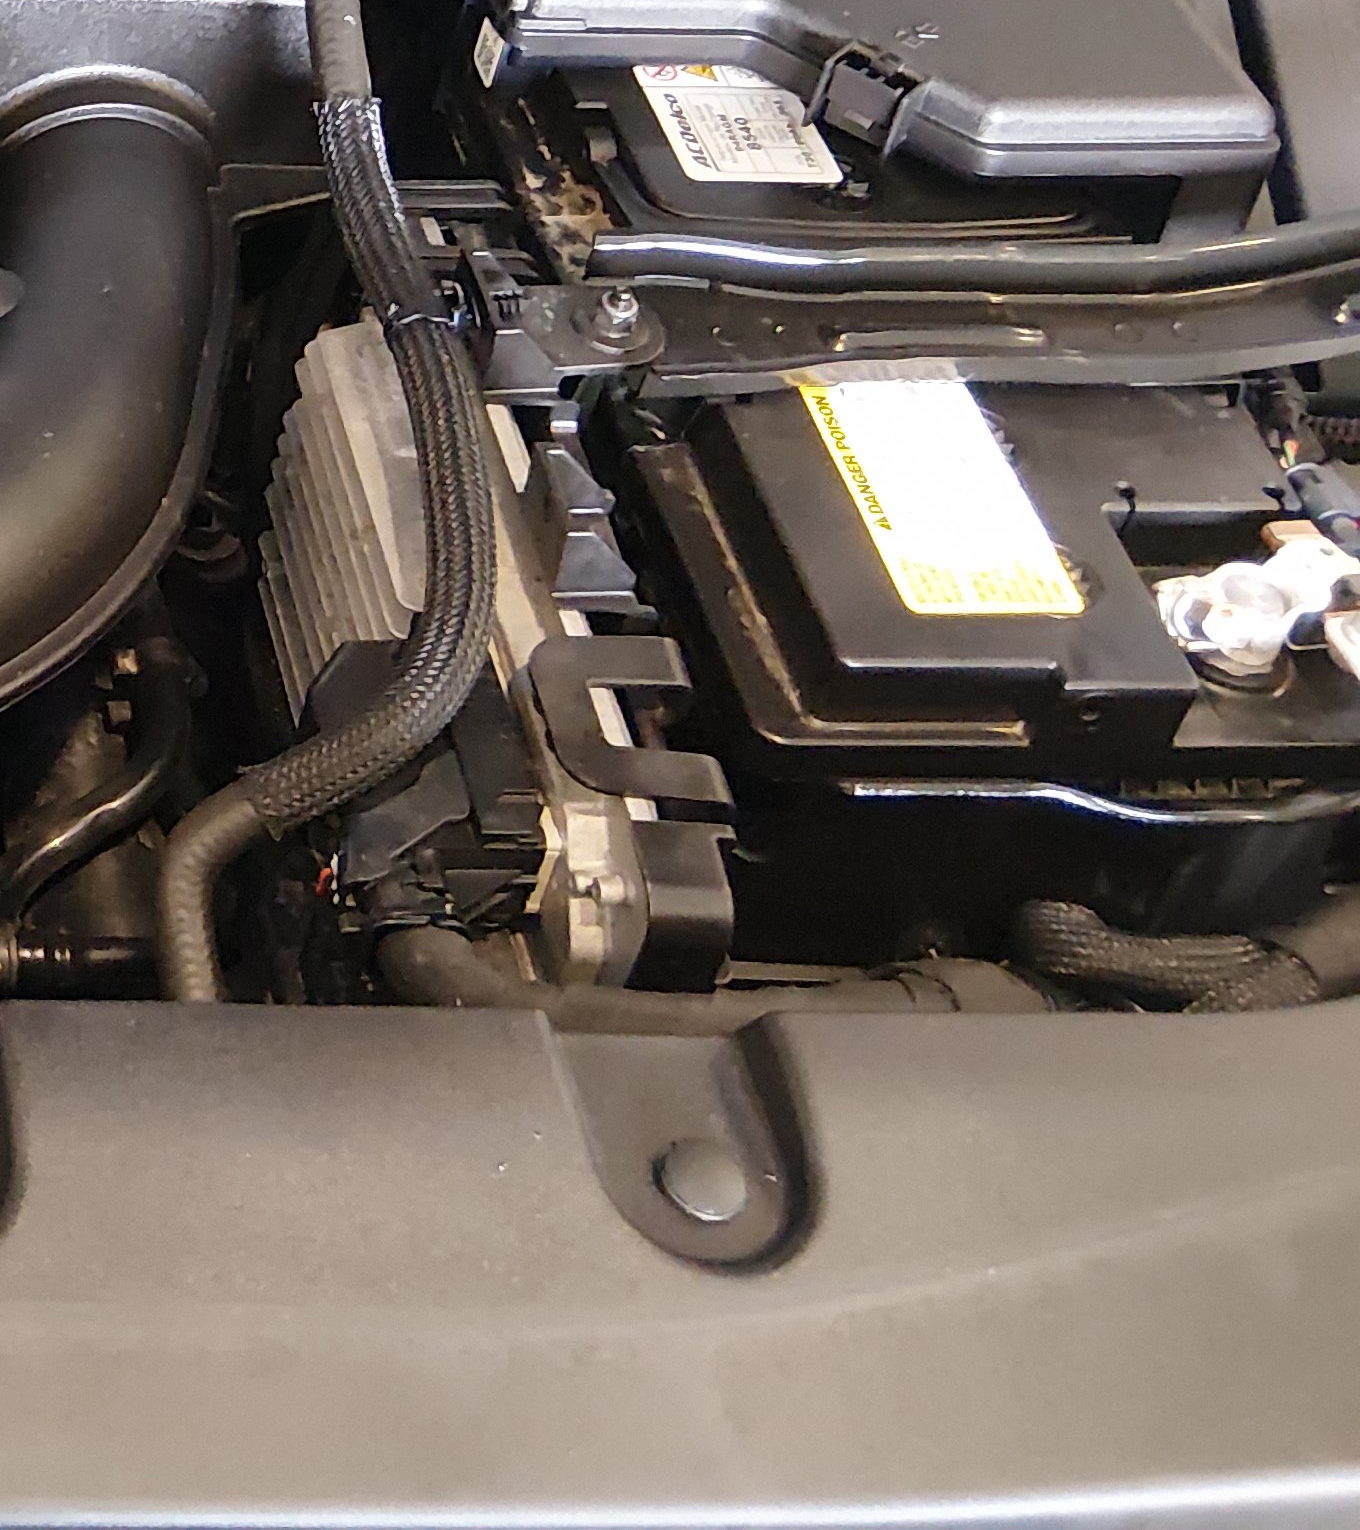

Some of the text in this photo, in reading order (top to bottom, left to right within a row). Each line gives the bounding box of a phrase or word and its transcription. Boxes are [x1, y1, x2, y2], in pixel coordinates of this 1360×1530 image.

[663, 93, 712, 169] ACDelco
[812, 395, 884, 514] DANGER POISON
